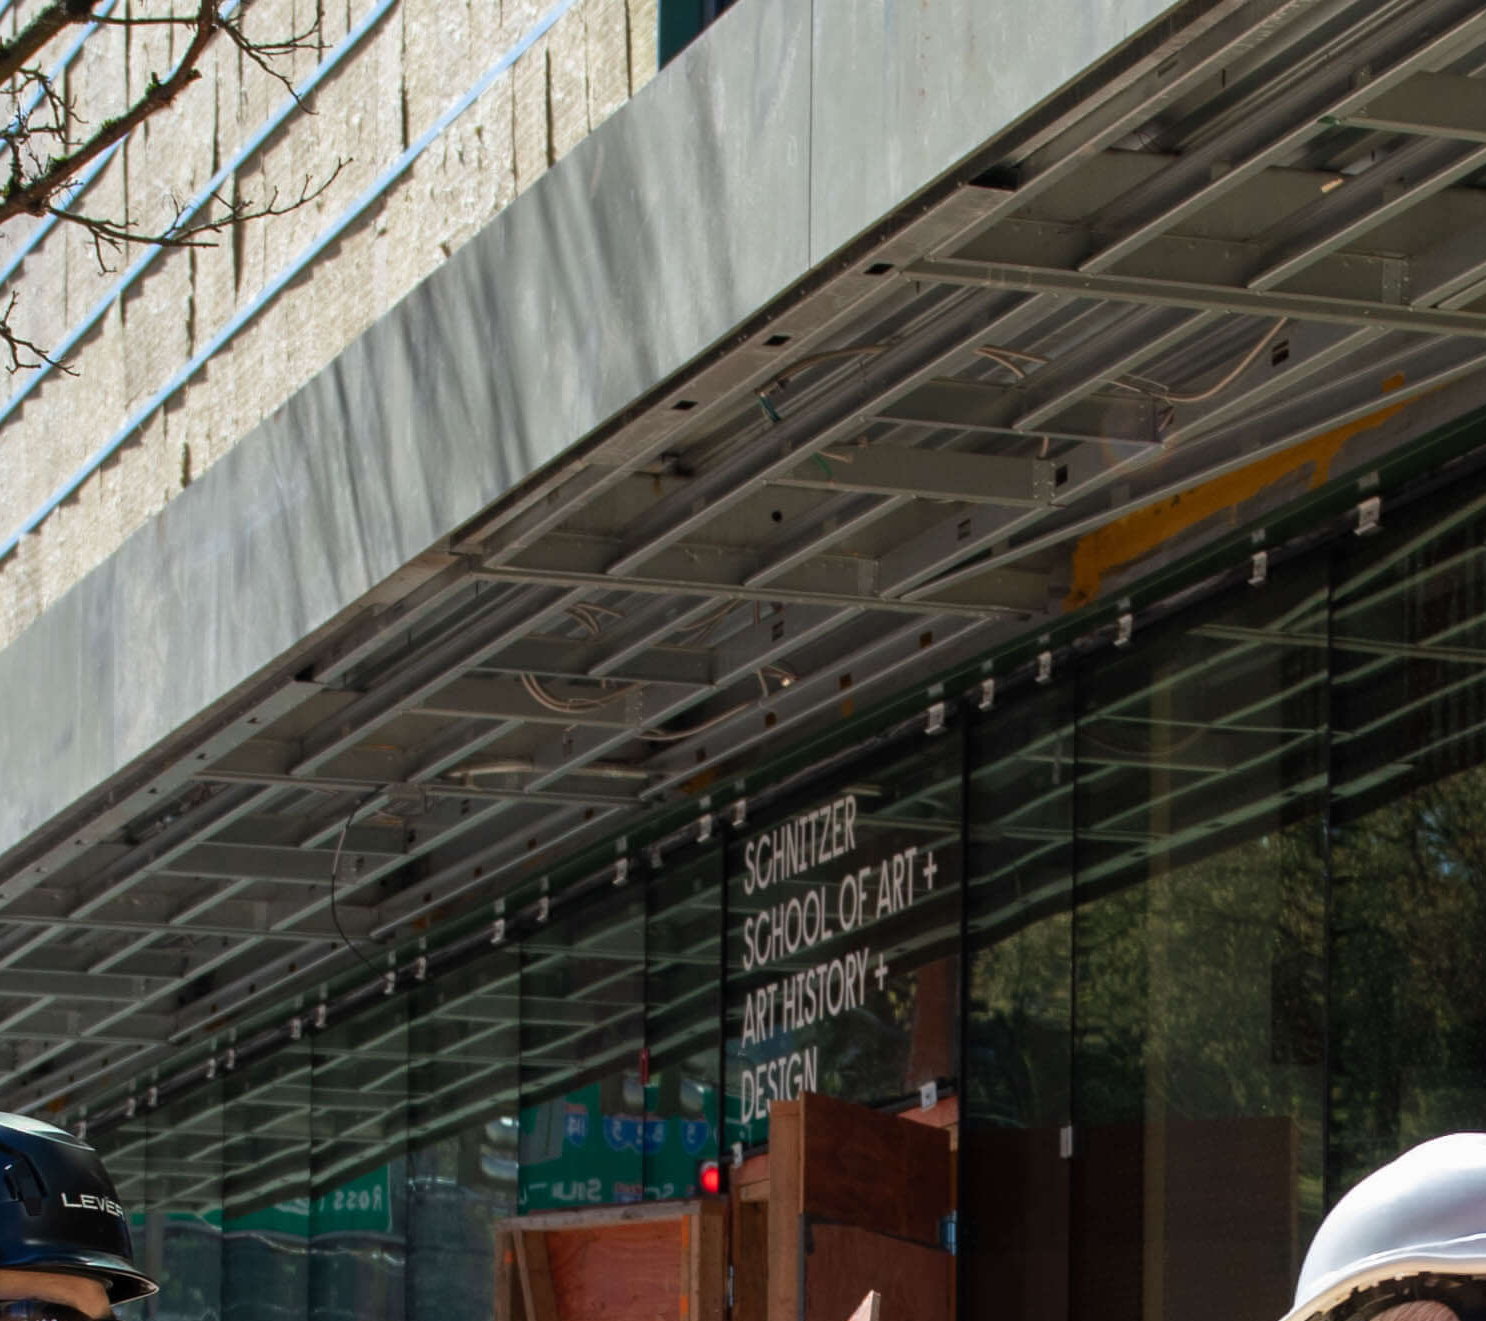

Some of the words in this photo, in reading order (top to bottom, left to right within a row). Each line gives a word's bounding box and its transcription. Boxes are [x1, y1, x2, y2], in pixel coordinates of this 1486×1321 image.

[744, 795, 857, 896] SCHNITZER
[742, 884, 832, 972] SCHOOL
[839, 866, 869, 932] OF
[876, 847, 918, 920] ART
[741, 982, 778, 1049] ART
[783, 947, 870, 1035] HISTORY
[741, 1046, 818, 1125] DESIGN
